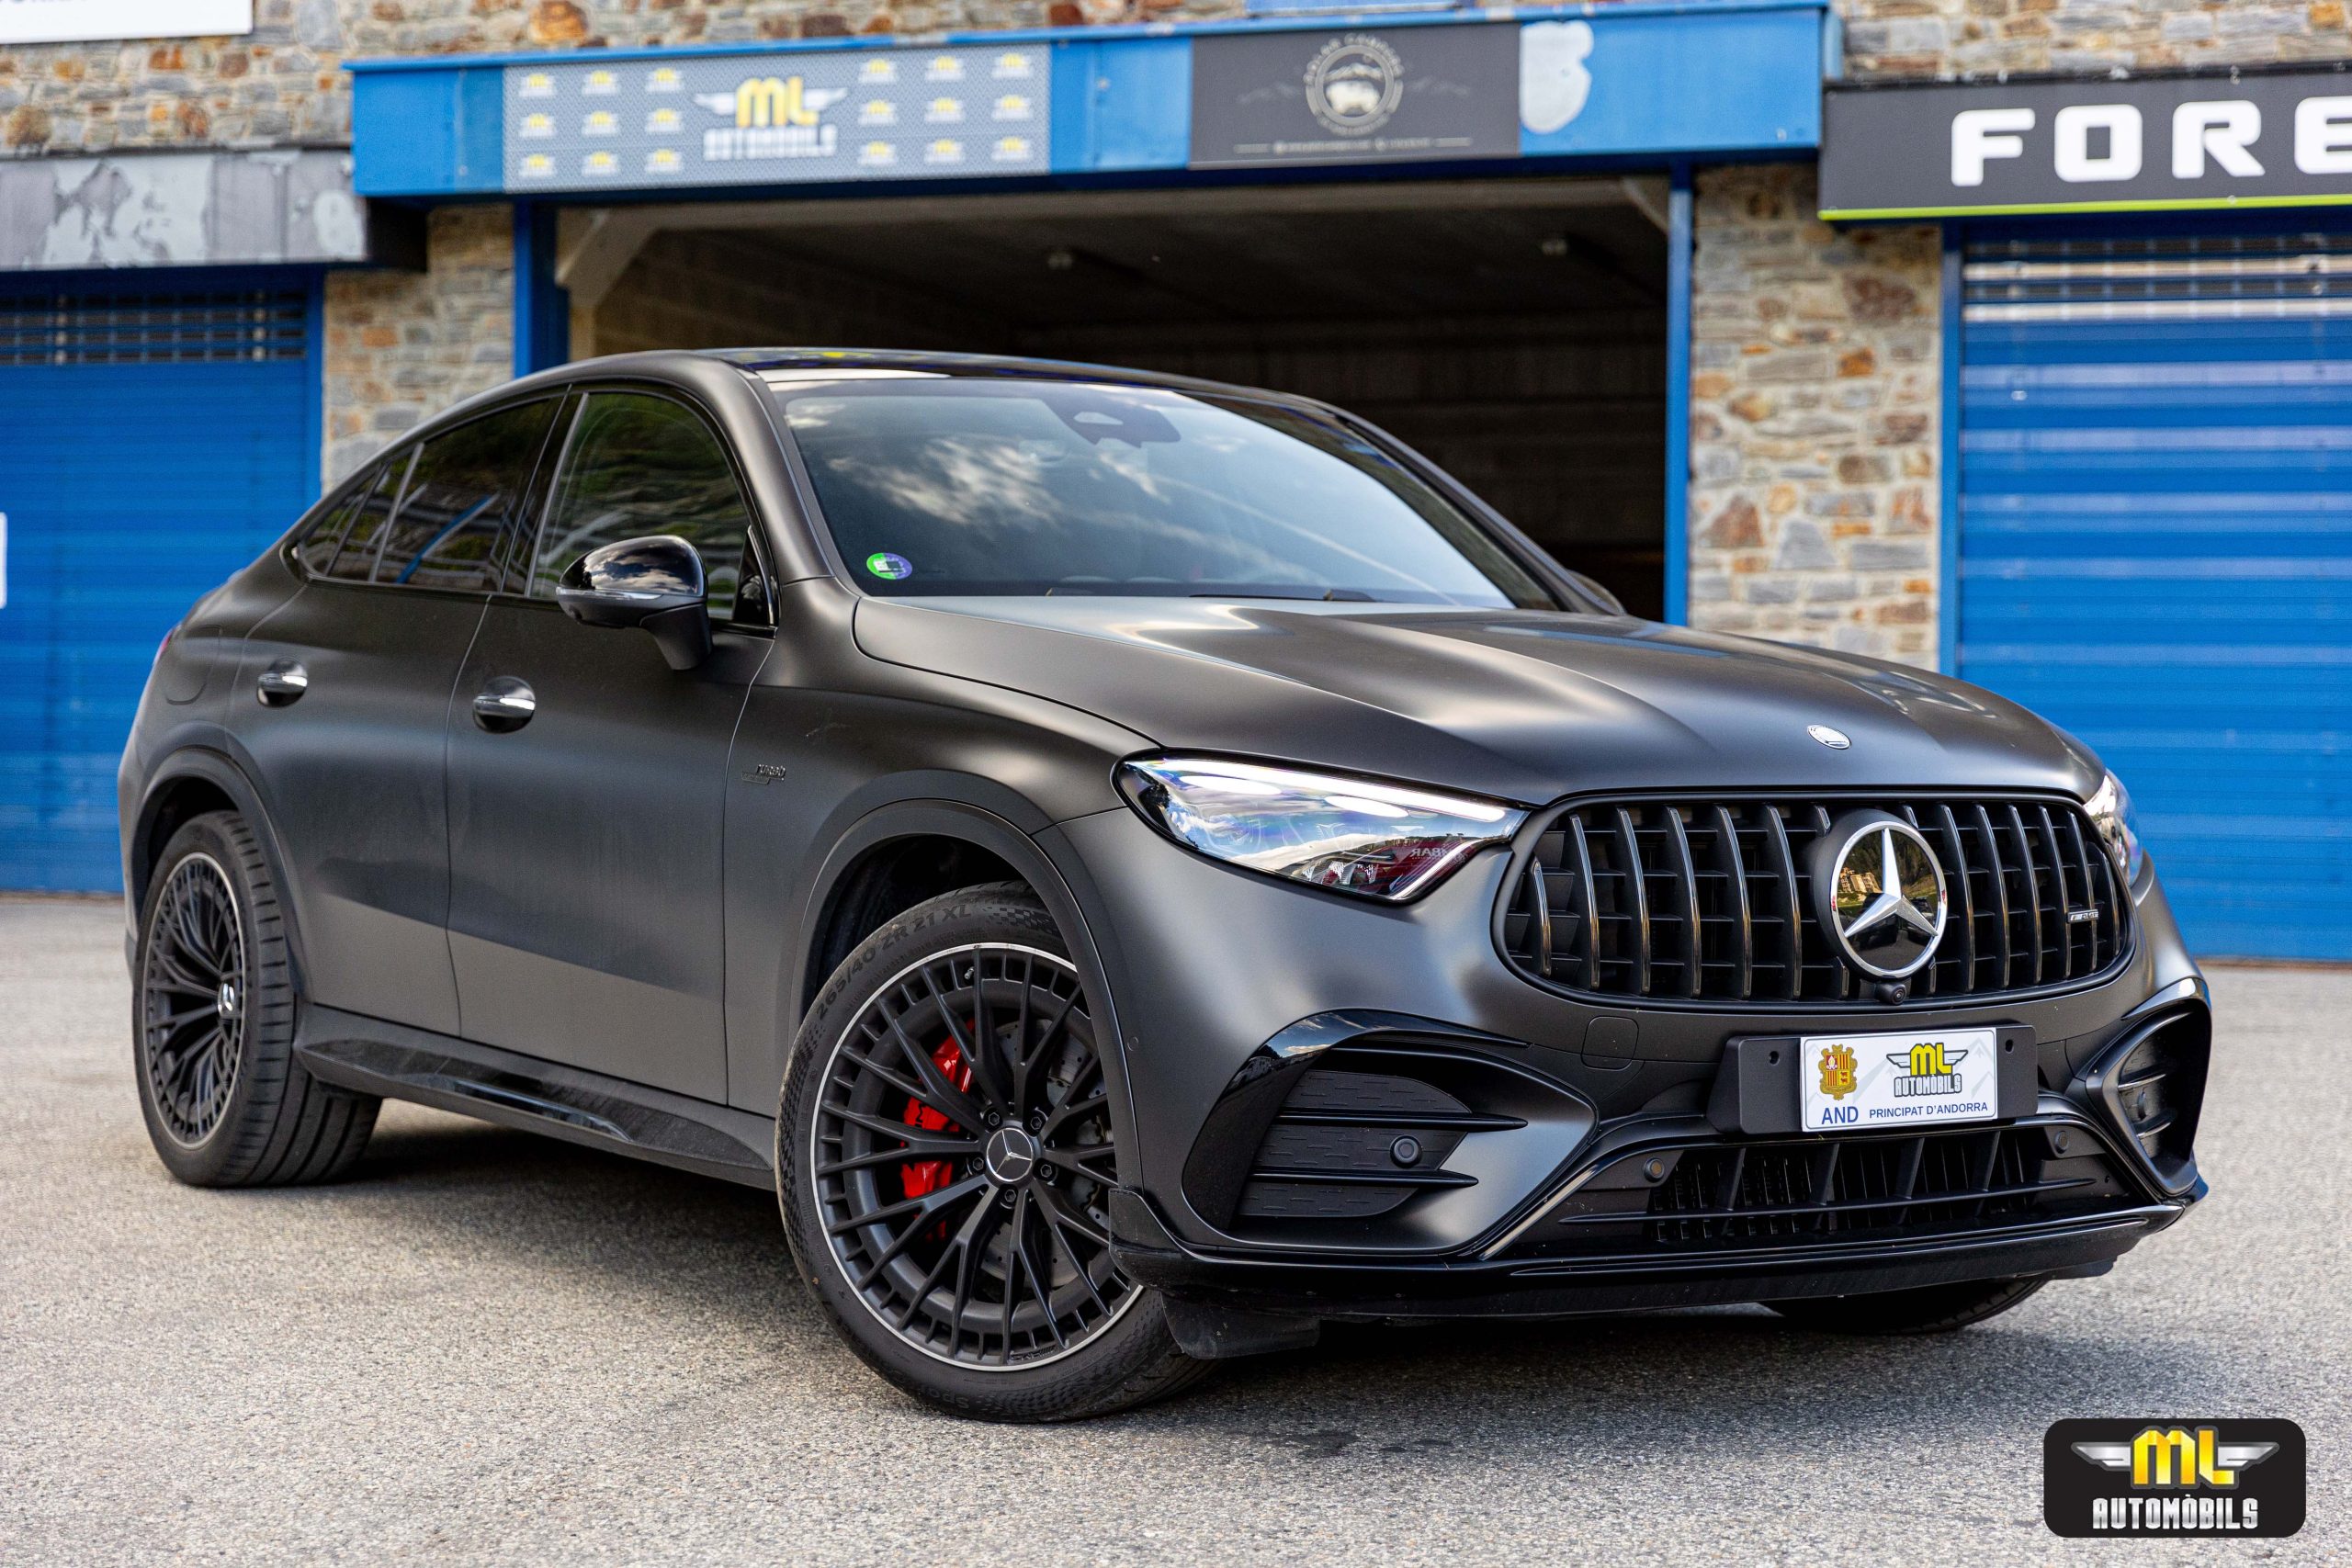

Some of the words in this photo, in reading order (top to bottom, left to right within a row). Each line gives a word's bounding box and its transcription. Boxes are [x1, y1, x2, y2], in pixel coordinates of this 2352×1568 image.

[736, 76, 820, 128] ML
[1951, 95, 2352, 186] FORE
[942, 904, 973, 923] XL
[1910, 1043, 1952, 1076] ML
[1821, 1105, 1860, 1125] AND
[1869, 1106, 1924, 1119] PRINCIPAT
[1926, 1101, 1988, 1115] D'ANDORRA
